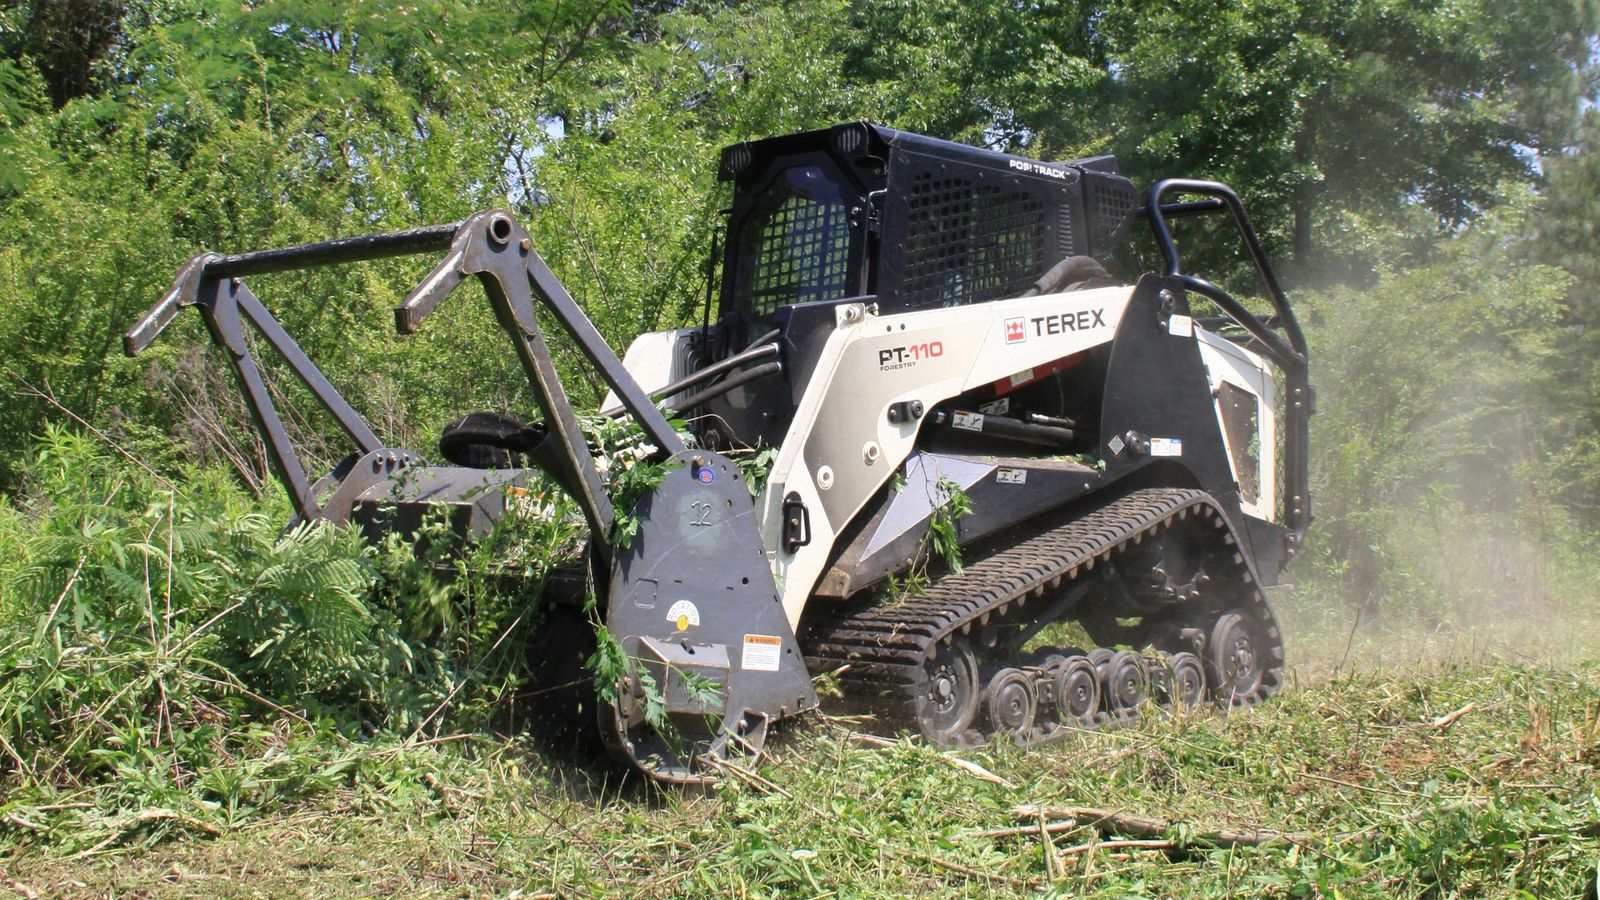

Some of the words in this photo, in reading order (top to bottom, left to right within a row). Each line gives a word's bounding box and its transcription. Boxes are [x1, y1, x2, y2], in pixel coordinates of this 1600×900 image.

[1030, 308, 1106, 337] TEREX
[879, 341, 943, 366] PT-110
[880, 361, 916, 371] FORESTRY
[690, 500, 712, 526] 12
